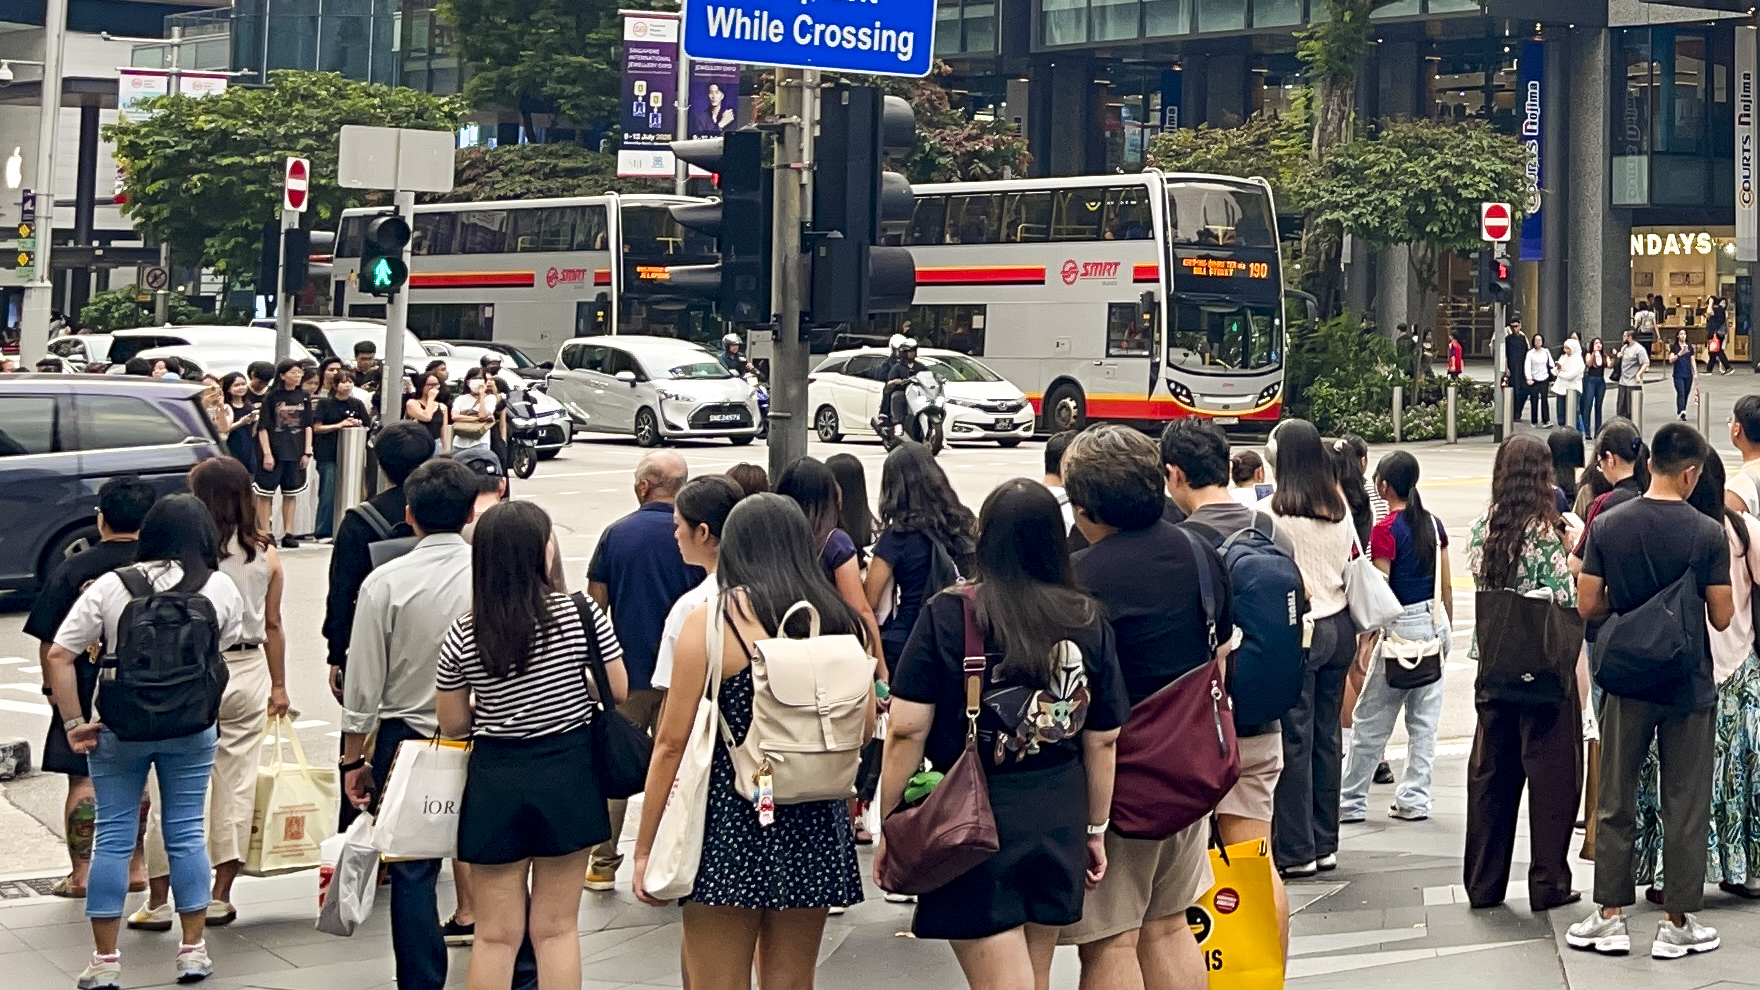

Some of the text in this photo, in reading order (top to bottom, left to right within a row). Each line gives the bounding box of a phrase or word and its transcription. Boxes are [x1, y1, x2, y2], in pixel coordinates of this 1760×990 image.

[706, 5, 914, 62] While Crossing
[641, 133, 656, 142] July
[1740, 134, 1753, 206] COURTS
[1630, 232, 1713, 256] NDAYS
[1079, 261, 1121, 277] SMRT
[1248, 262, 1268, 279] 190
[1287, 590, 1298, 626] THULE
